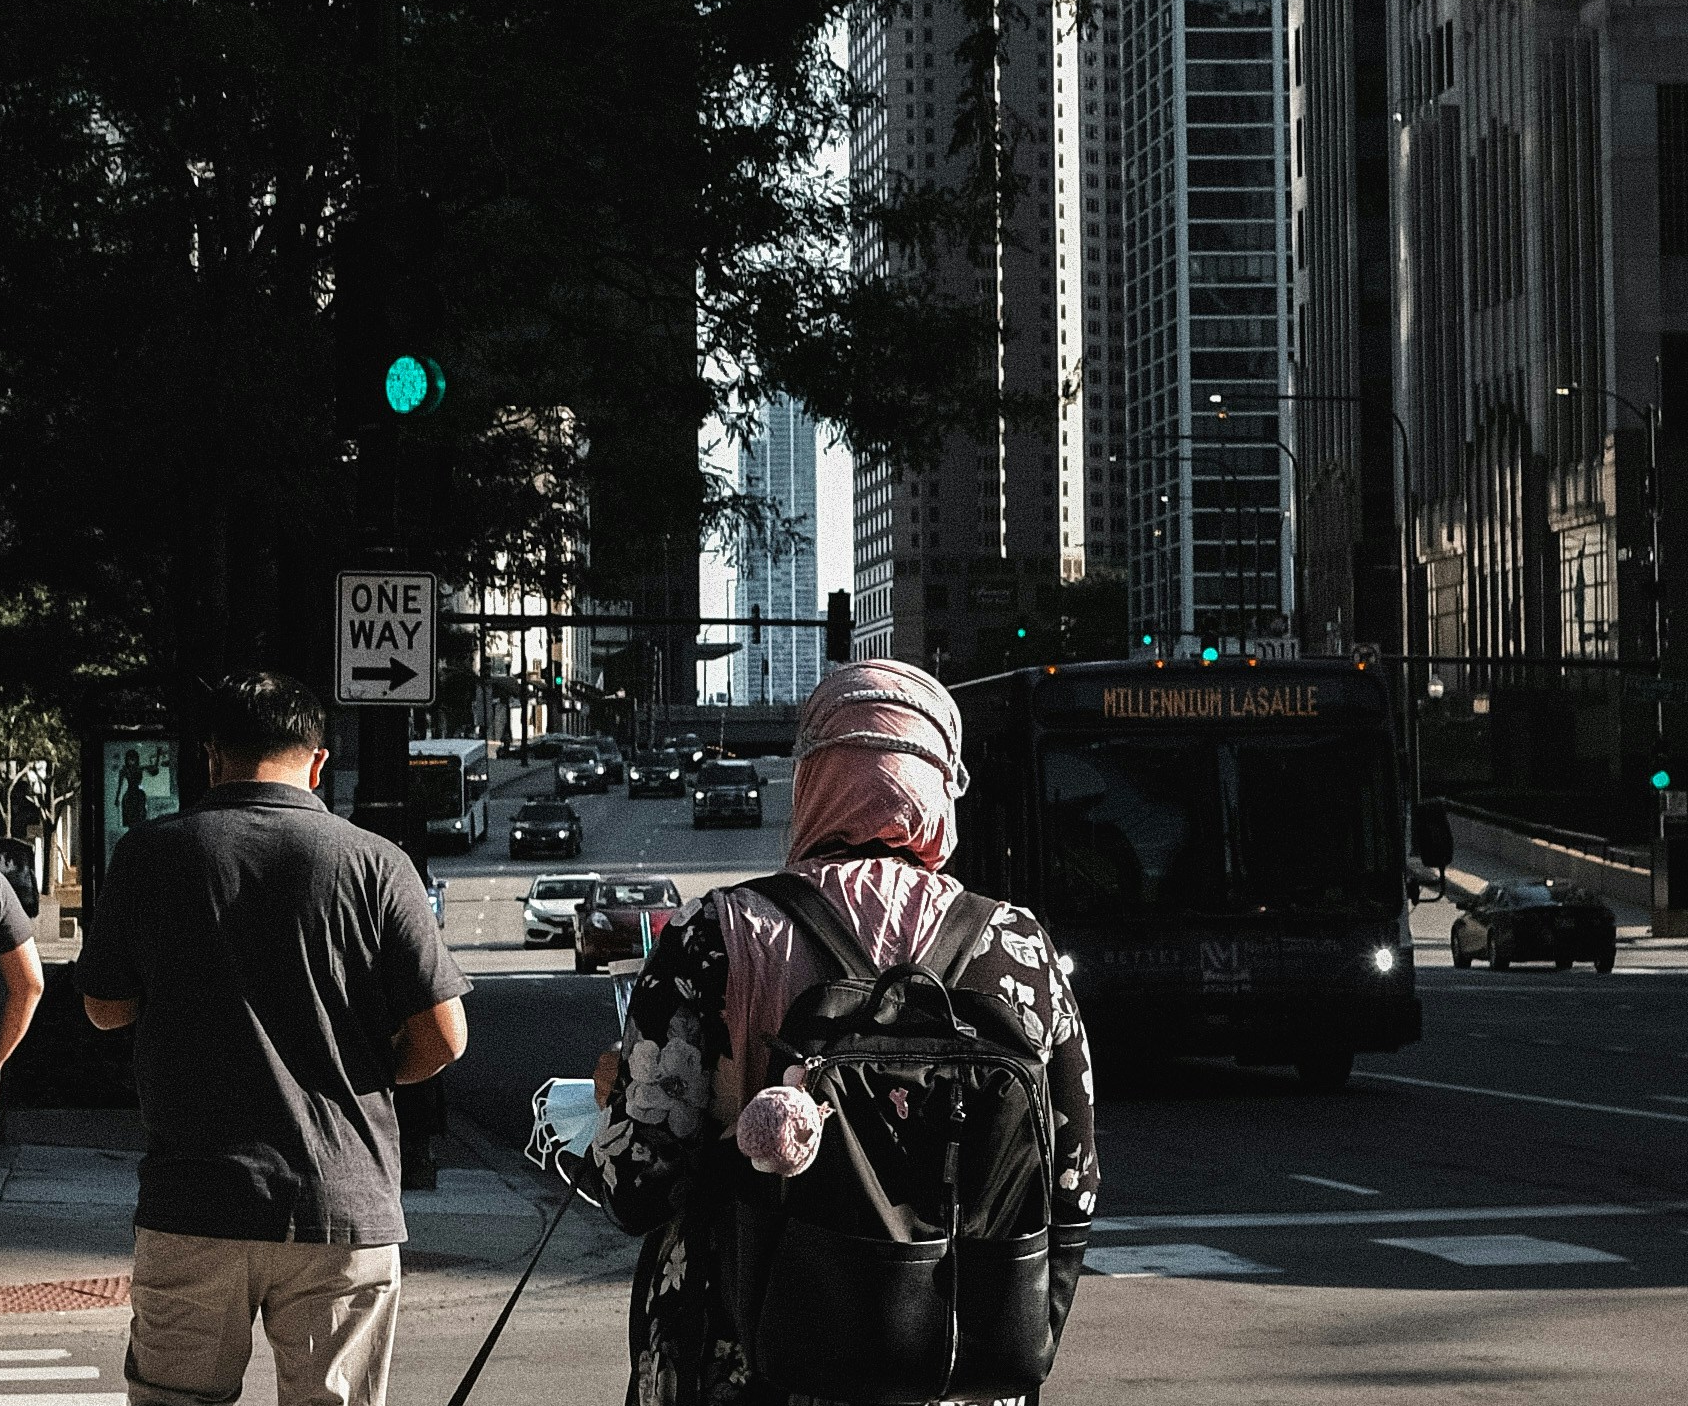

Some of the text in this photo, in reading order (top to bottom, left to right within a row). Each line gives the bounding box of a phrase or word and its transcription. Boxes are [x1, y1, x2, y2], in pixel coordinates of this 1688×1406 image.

[351, 583, 422, 614] ONE
[349, 619, 423, 650] WAY
[1104, 686, 1320, 718] MILLENNIUM LASALLE
